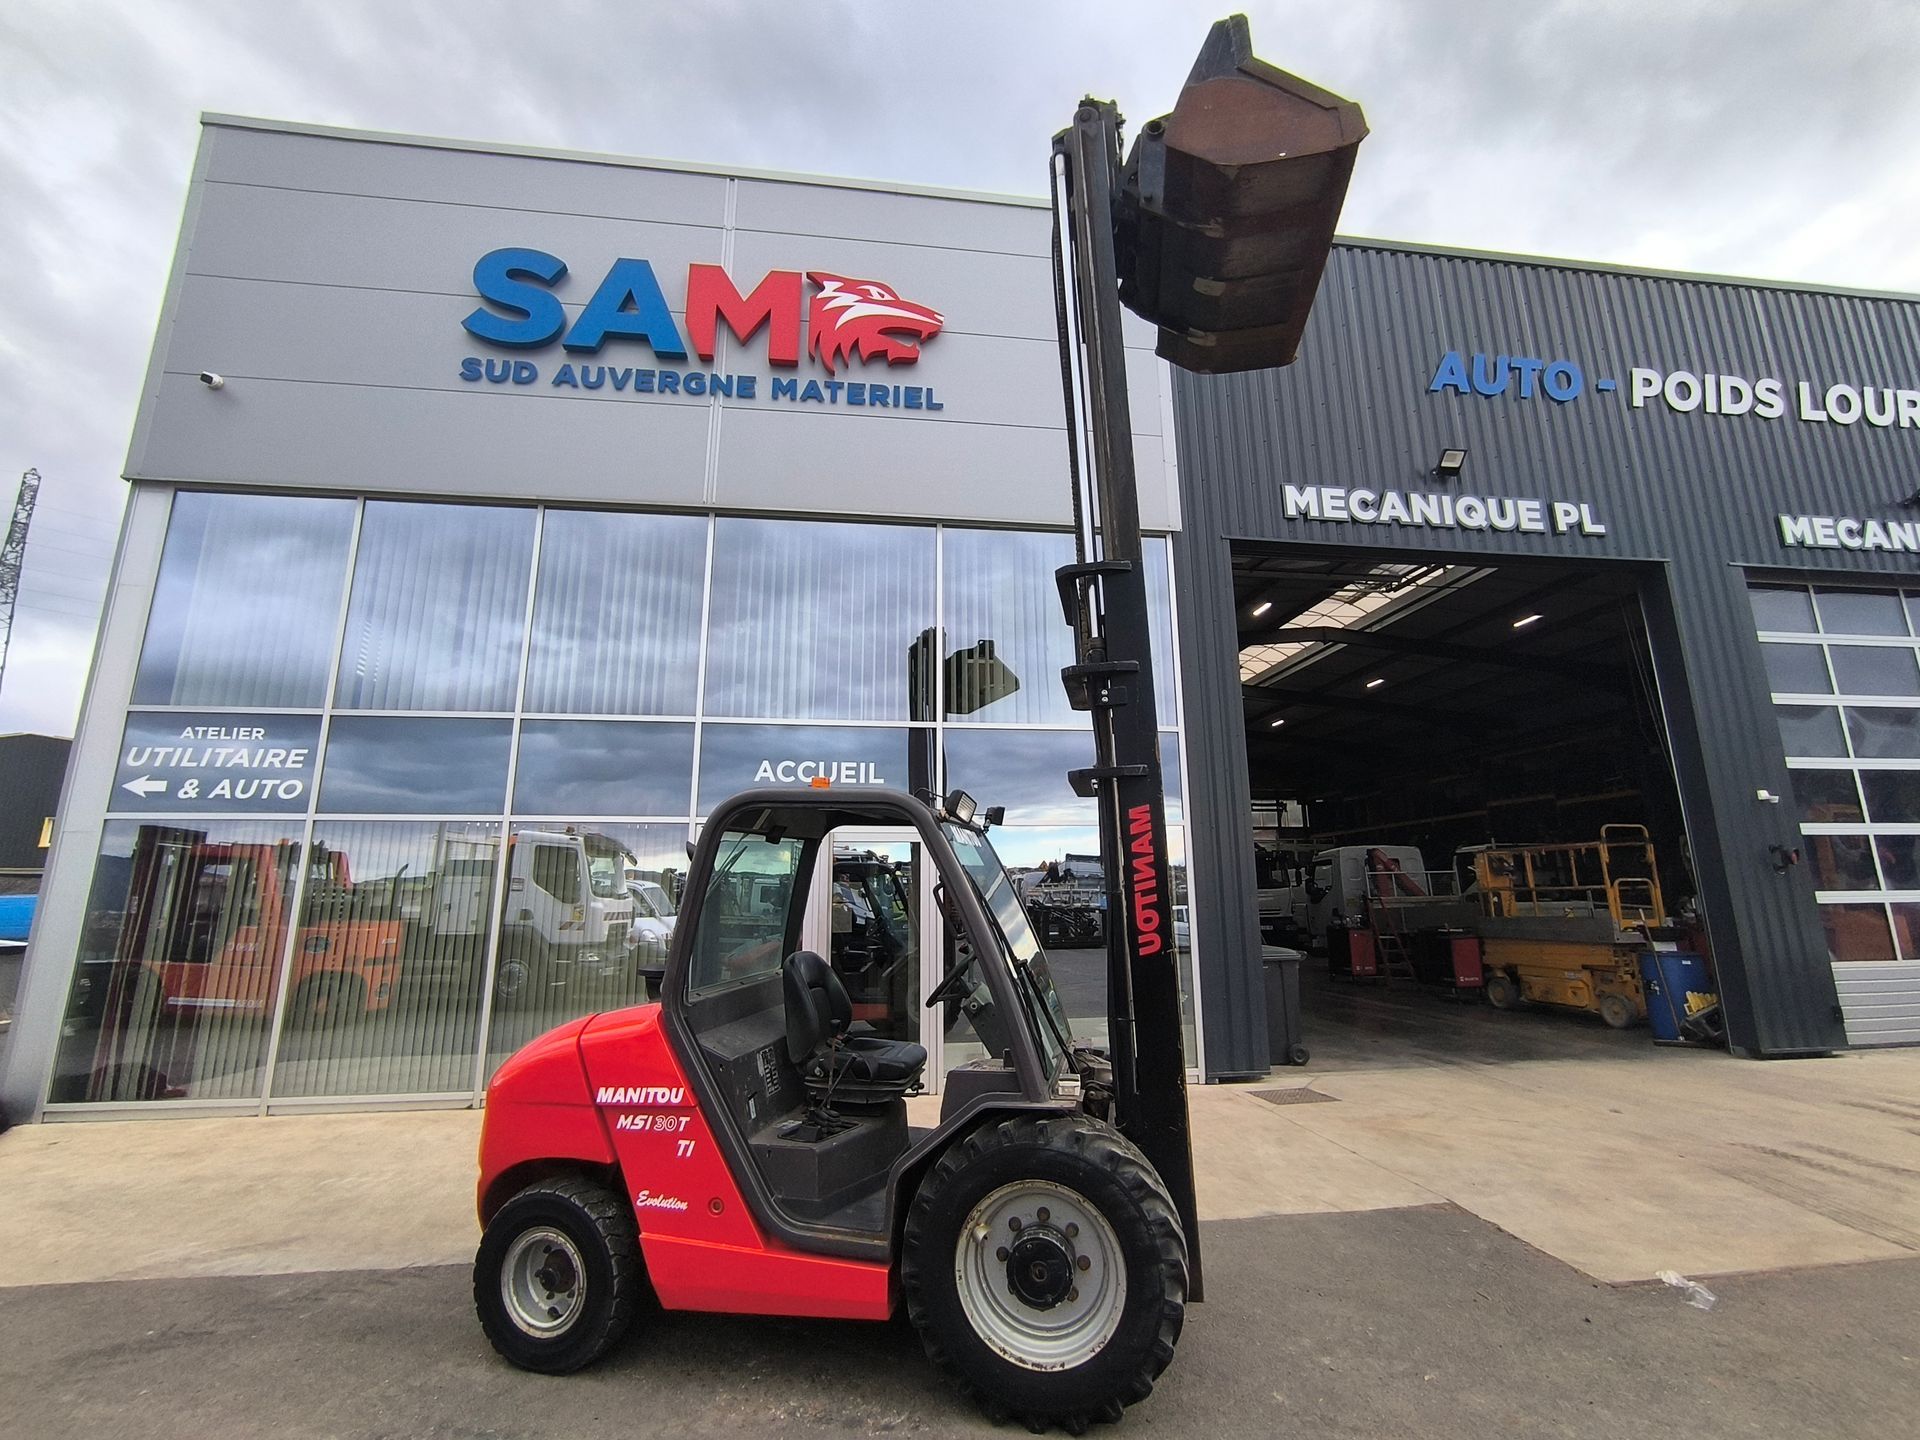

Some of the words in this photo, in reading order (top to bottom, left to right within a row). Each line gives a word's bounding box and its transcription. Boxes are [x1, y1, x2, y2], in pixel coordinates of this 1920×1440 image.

[461, 247, 803, 367] SAM
[459, 357, 538, 385] SUD
[552, 363, 757, 399] AUVERGNE
[771, 377, 944, 410] MATERIEL
[1430, 351, 1582, 402] AUTO
[1631, 368, 1785, 420] POIDS
[1797, 381, 1920, 428] LOUR
[1283, 484, 1544, 532] MECANIQUE
[1553, 501, 1606, 536] PL
[1779, 514, 1920, 551] MECAN
[180, 727, 265, 740] ATELIER
[126, 747, 308, 769] UTILITAIRE
[754, 760, 885, 784] ACCUEIL
[177, 779, 200, 799] &
[207, 779, 303, 800] AUTO
[596, 1087, 685, 1104] MANITOU
[677, 1140, 695, 1157] TI
[637, 1190, 688, 1210] Evolution
